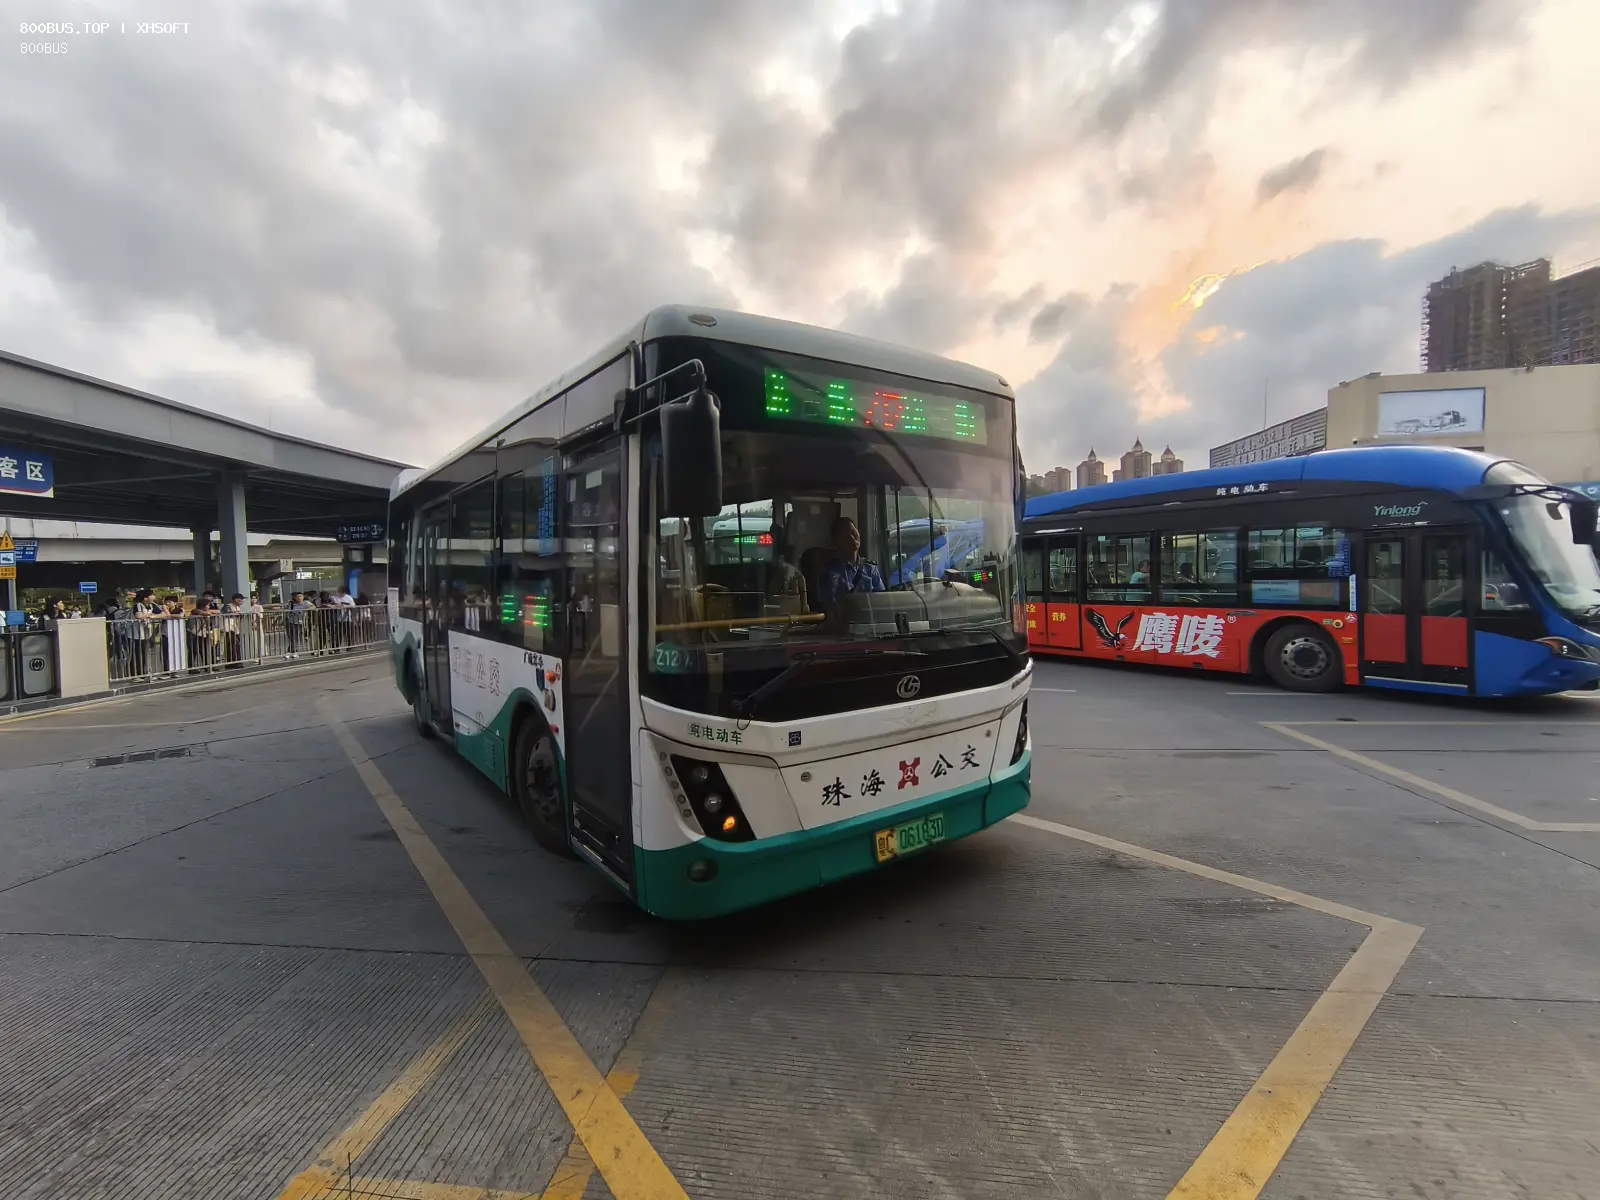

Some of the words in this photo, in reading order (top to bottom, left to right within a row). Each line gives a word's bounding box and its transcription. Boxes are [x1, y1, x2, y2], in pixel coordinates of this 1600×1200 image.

[1374, 503, 1422, 516] Yinlong
[821, 769, 886, 807] 珠海
[929, 744, 980, 779] 公交
